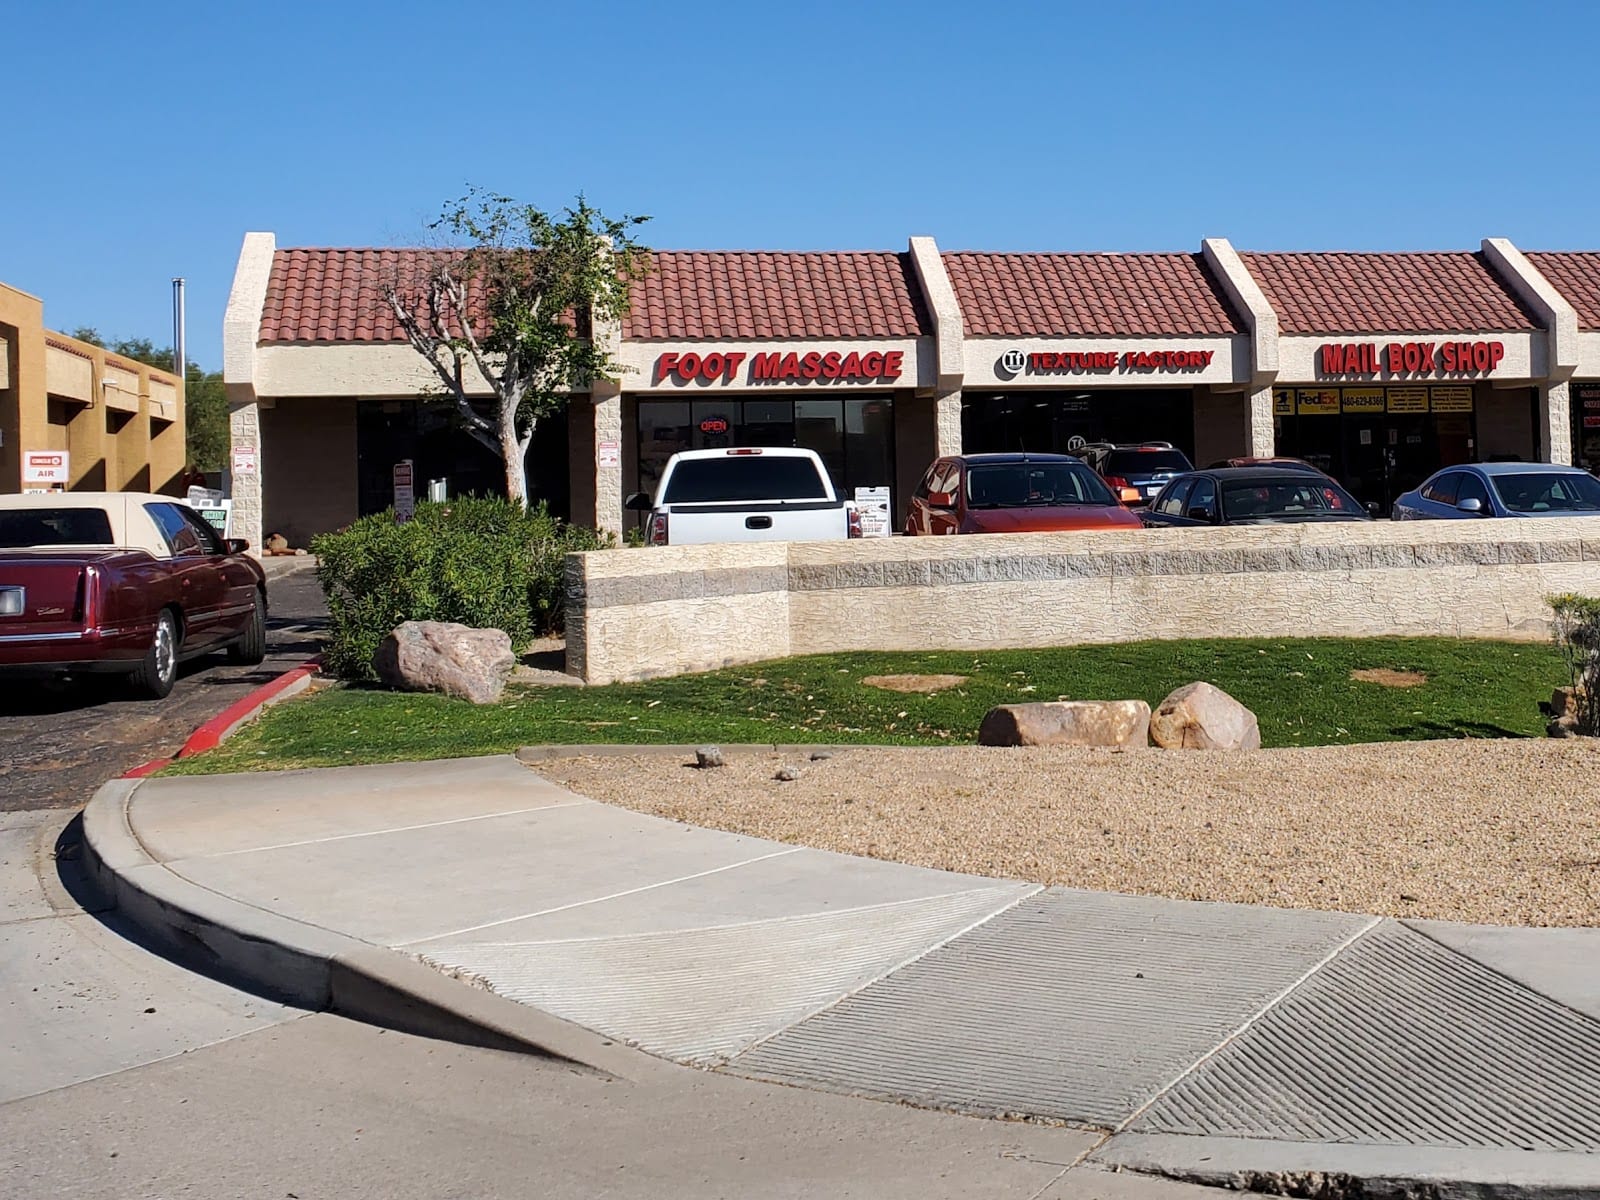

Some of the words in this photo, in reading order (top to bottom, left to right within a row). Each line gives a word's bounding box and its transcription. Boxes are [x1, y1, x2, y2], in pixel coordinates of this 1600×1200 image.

[657, 352, 747, 380] FOOT
[753, 351, 905, 379] MASSAGE
[1030, 352, 1119, 369] TEXTURE
[1126, 351, 1215, 368] FACTORY
[1322, 343, 1382, 374] MAIL
[1388, 342, 1437, 373] BOX
[1442, 341, 1505, 372] SHOP
[1298, 391, 1337, 405] FedEx
[701, 420, 727, 431] OPEN
